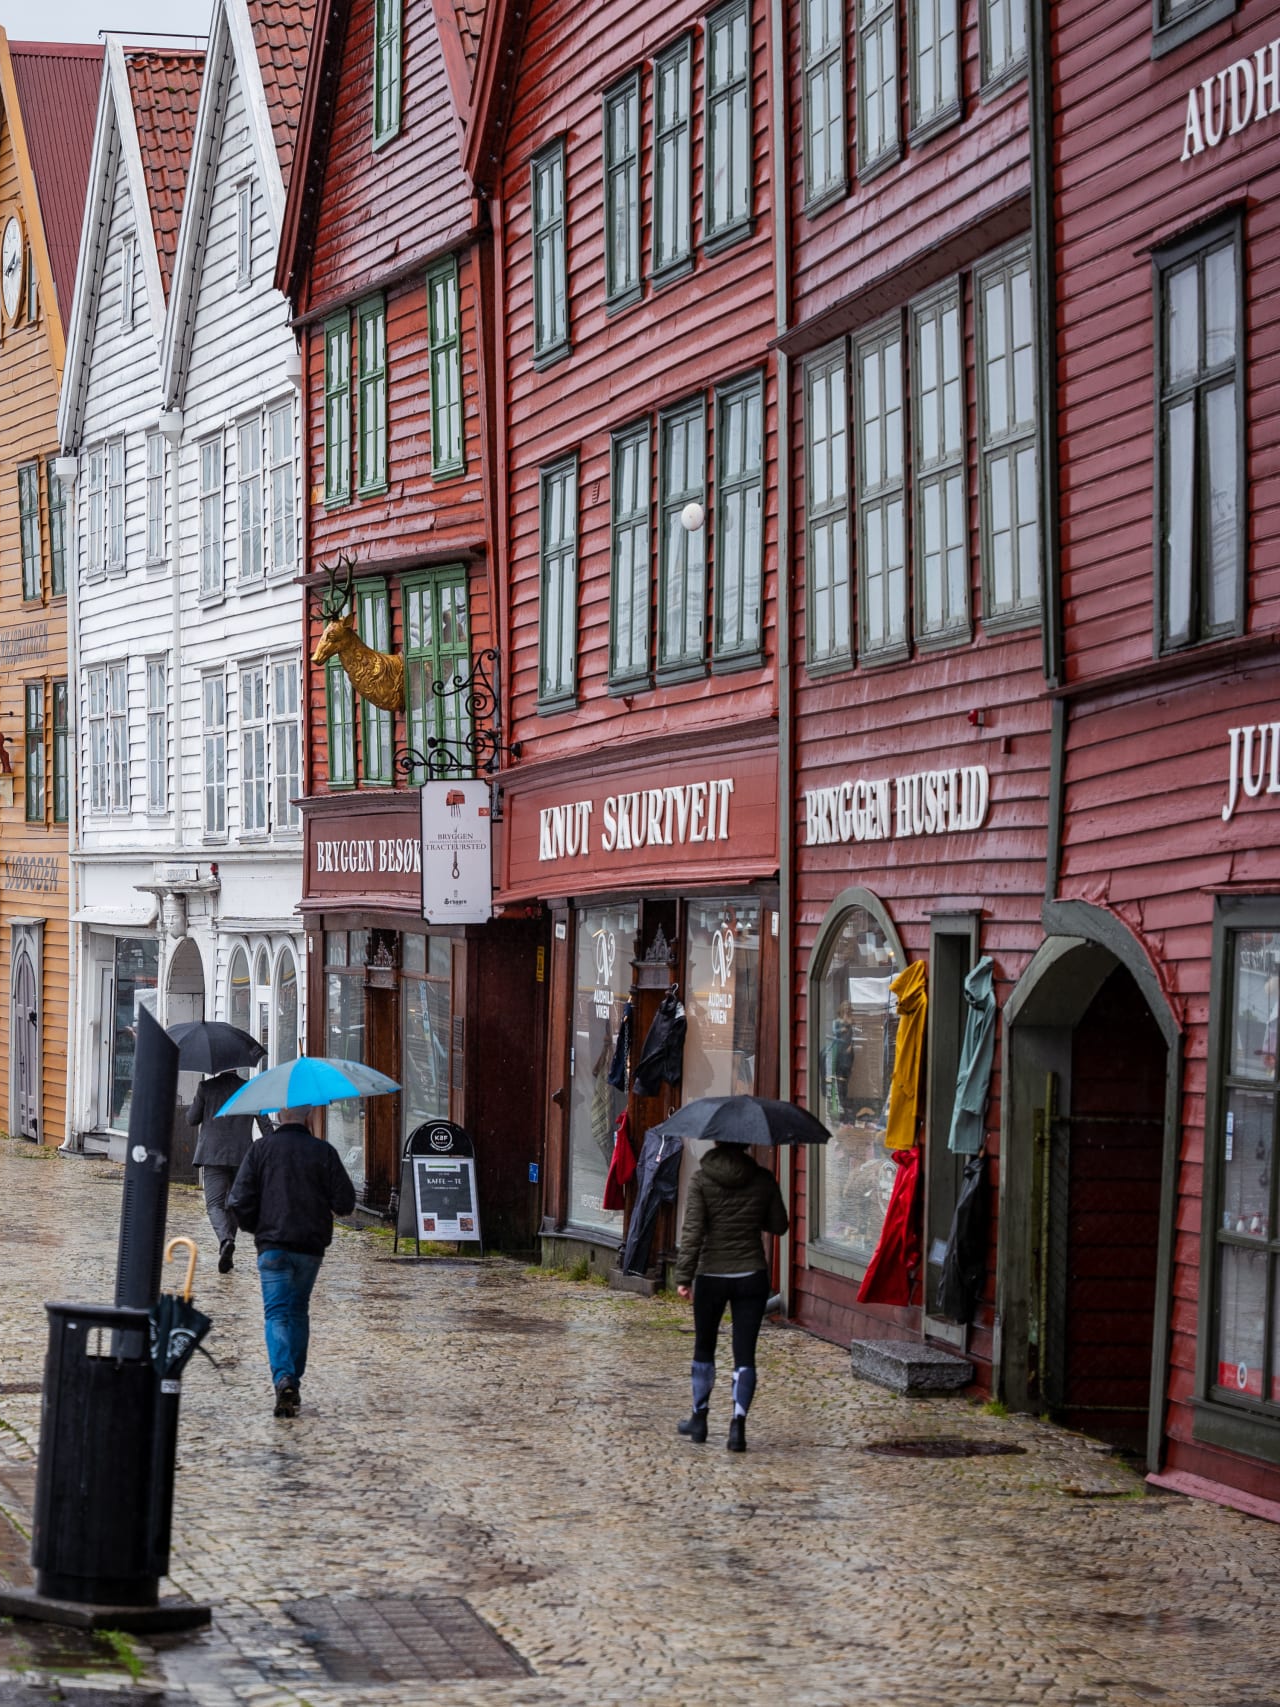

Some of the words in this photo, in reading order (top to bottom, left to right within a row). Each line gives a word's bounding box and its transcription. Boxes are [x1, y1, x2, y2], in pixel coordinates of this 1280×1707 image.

[805, 778, 891, 845] BRYGGEN
[895, 765, 990, 838] HUSFLID
[539, 800, 593, 861] KNUT
[601, 778, 734, 851] SKURTVEIT
[437, 833, 474, 841] BRYGGEN
[317, 840, 375, 872] BRYGGEN
[594, 990, 614, 1005] AUDHILD
[708, 992, 732, 1008] AUDHILD
[596, 1005, 610, 1019] VIKEN
[711, 1009, 727, 1024] VIKEN
